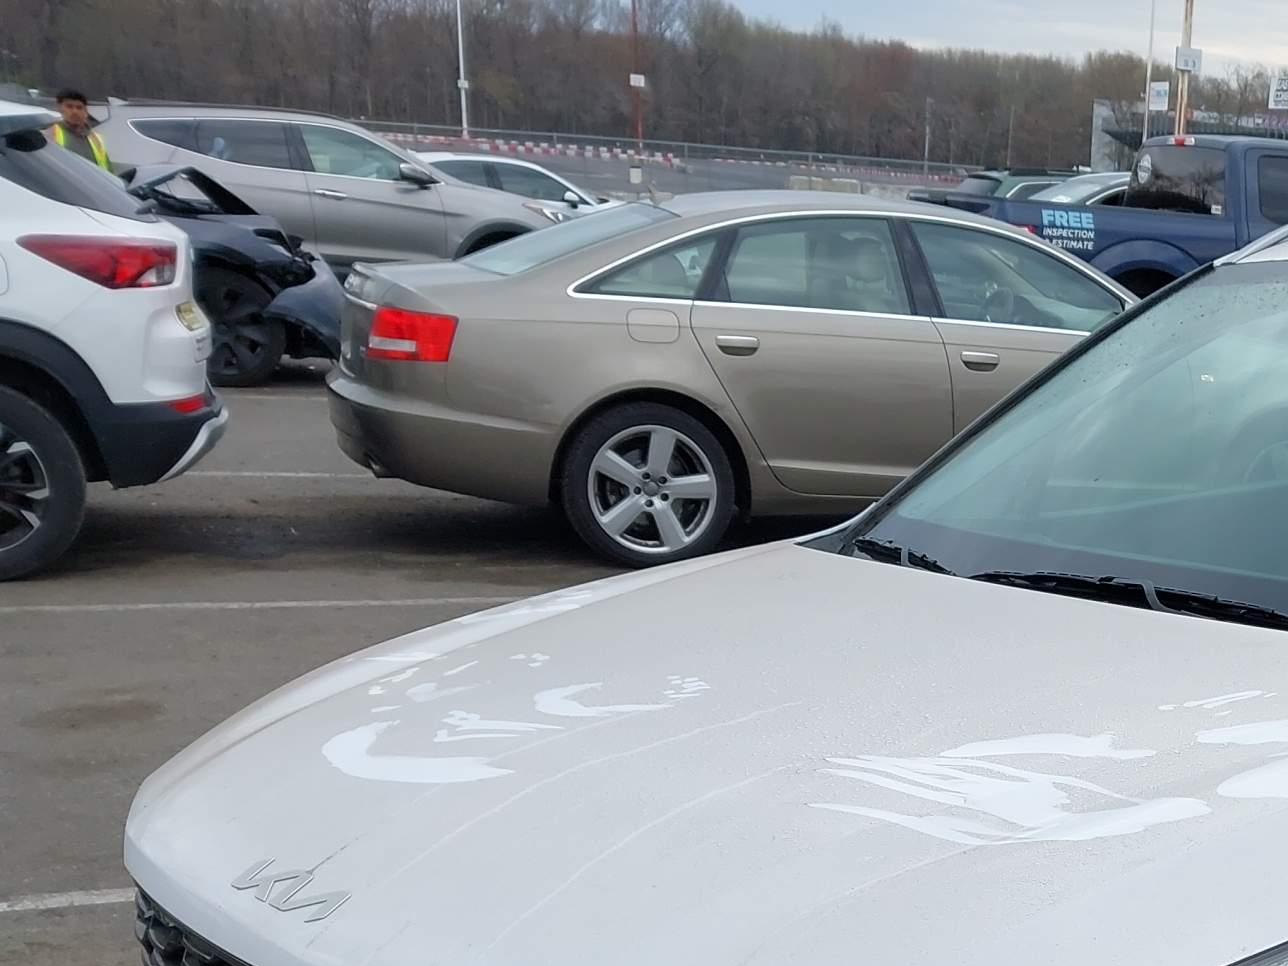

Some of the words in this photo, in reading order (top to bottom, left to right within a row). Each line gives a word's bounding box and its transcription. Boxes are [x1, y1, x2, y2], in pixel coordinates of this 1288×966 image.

[1041, 209, 1094, 228] FREE
[1043, 227, 1095, 239] INSPECTION
[231, 857, 352, 924] KIA
